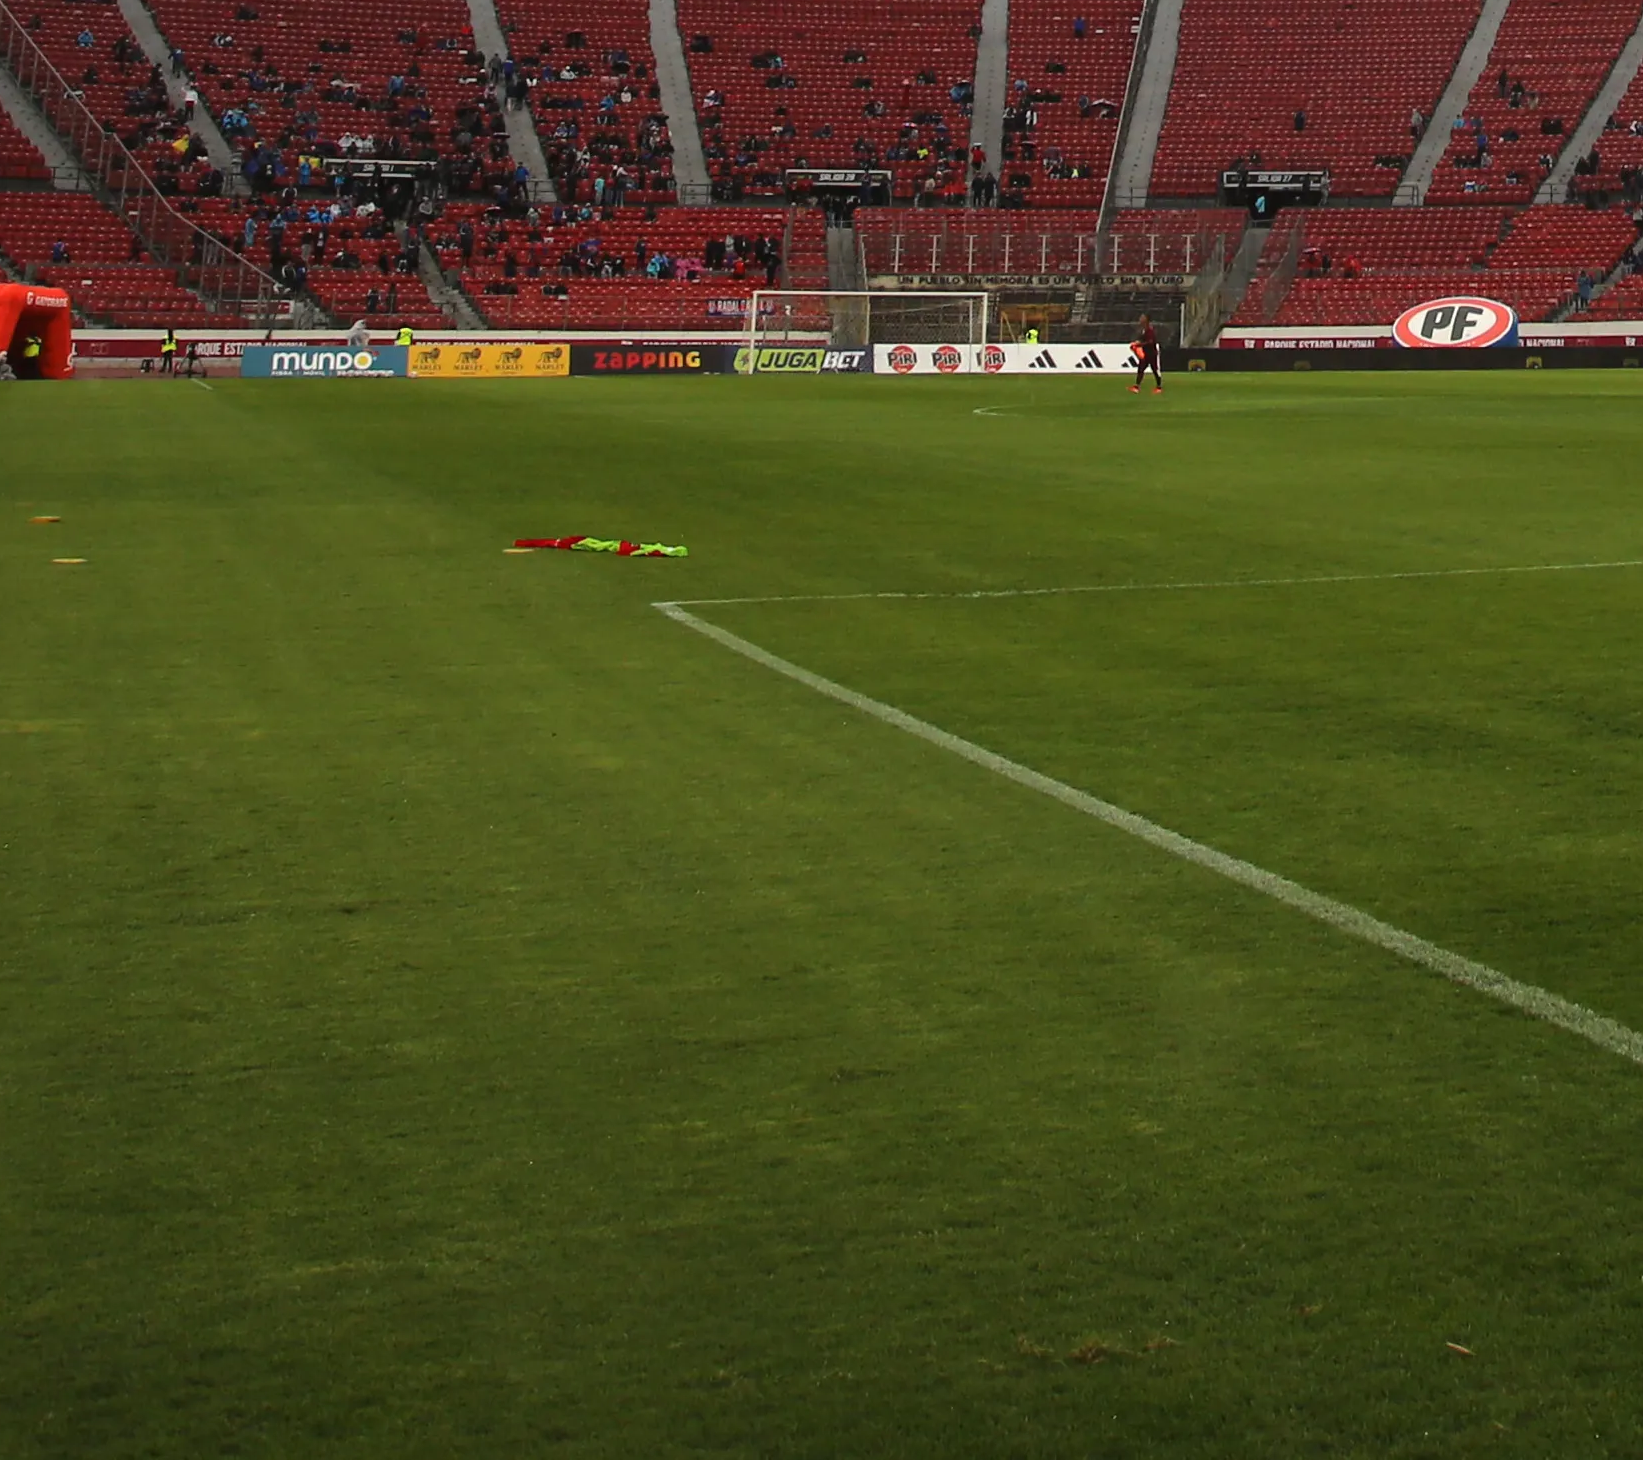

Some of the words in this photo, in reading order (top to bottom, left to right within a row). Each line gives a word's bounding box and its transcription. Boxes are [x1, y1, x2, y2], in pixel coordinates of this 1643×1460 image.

[819, 173, 844, 181] SALIDA
[1257, 174, 1282, 182] SALIDA
[1282, 174, 1293, 182] 27
[1420, 306, 1484, 342] PF
[760, 351, 818, 369] JUGA
[820, 351, 867, 369] BET
